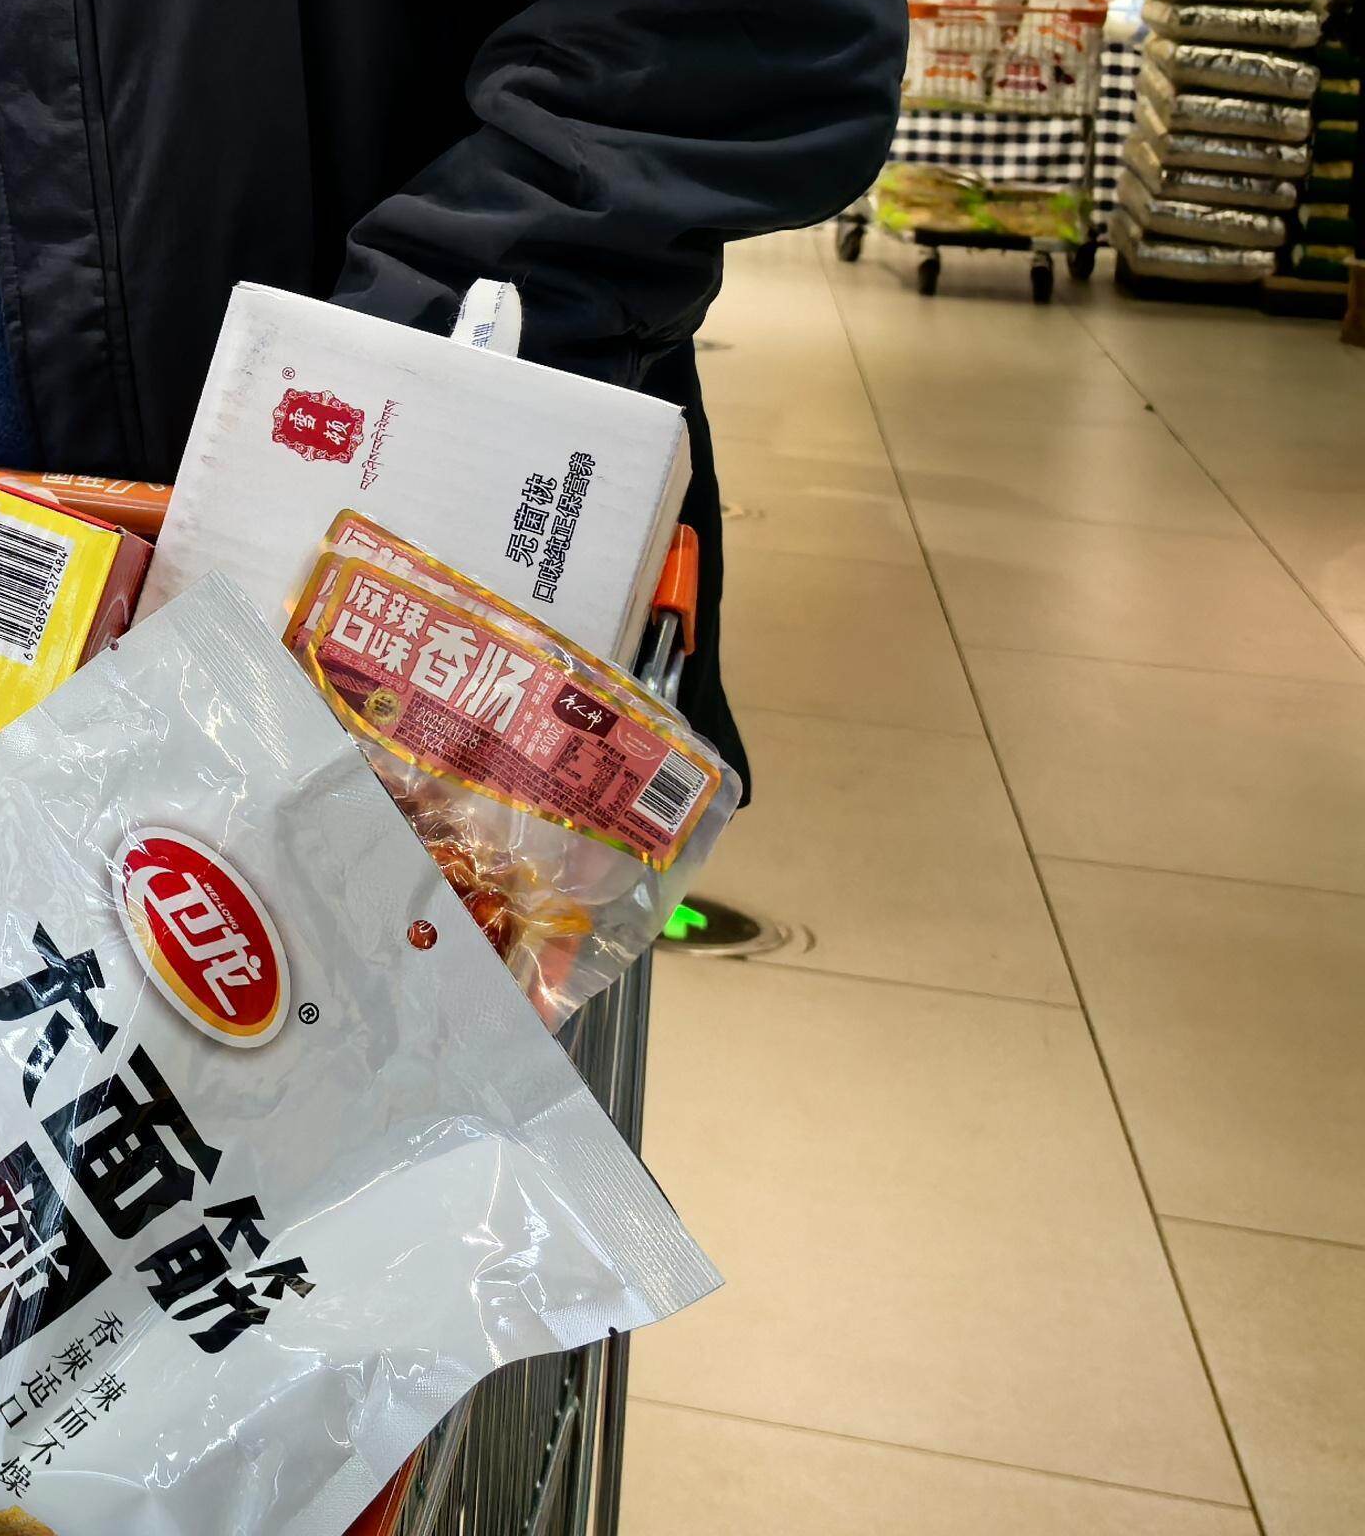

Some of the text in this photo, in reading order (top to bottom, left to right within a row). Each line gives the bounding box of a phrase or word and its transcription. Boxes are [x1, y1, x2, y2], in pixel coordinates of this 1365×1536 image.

[286, 410, 351, 443] 雪顿
[505, 473, 557, 567] 无菌枕
[532, 452, 597, 604] 口味纯正保营养
[331, 611, 411, 676] 口味
[344, 575, 430, 641] 麻辣
[409, 619, 537, 734] 香肠
[137, 864, 263, 1019] 卫龙
[202, 882, 241, 931] WEI-LONG
